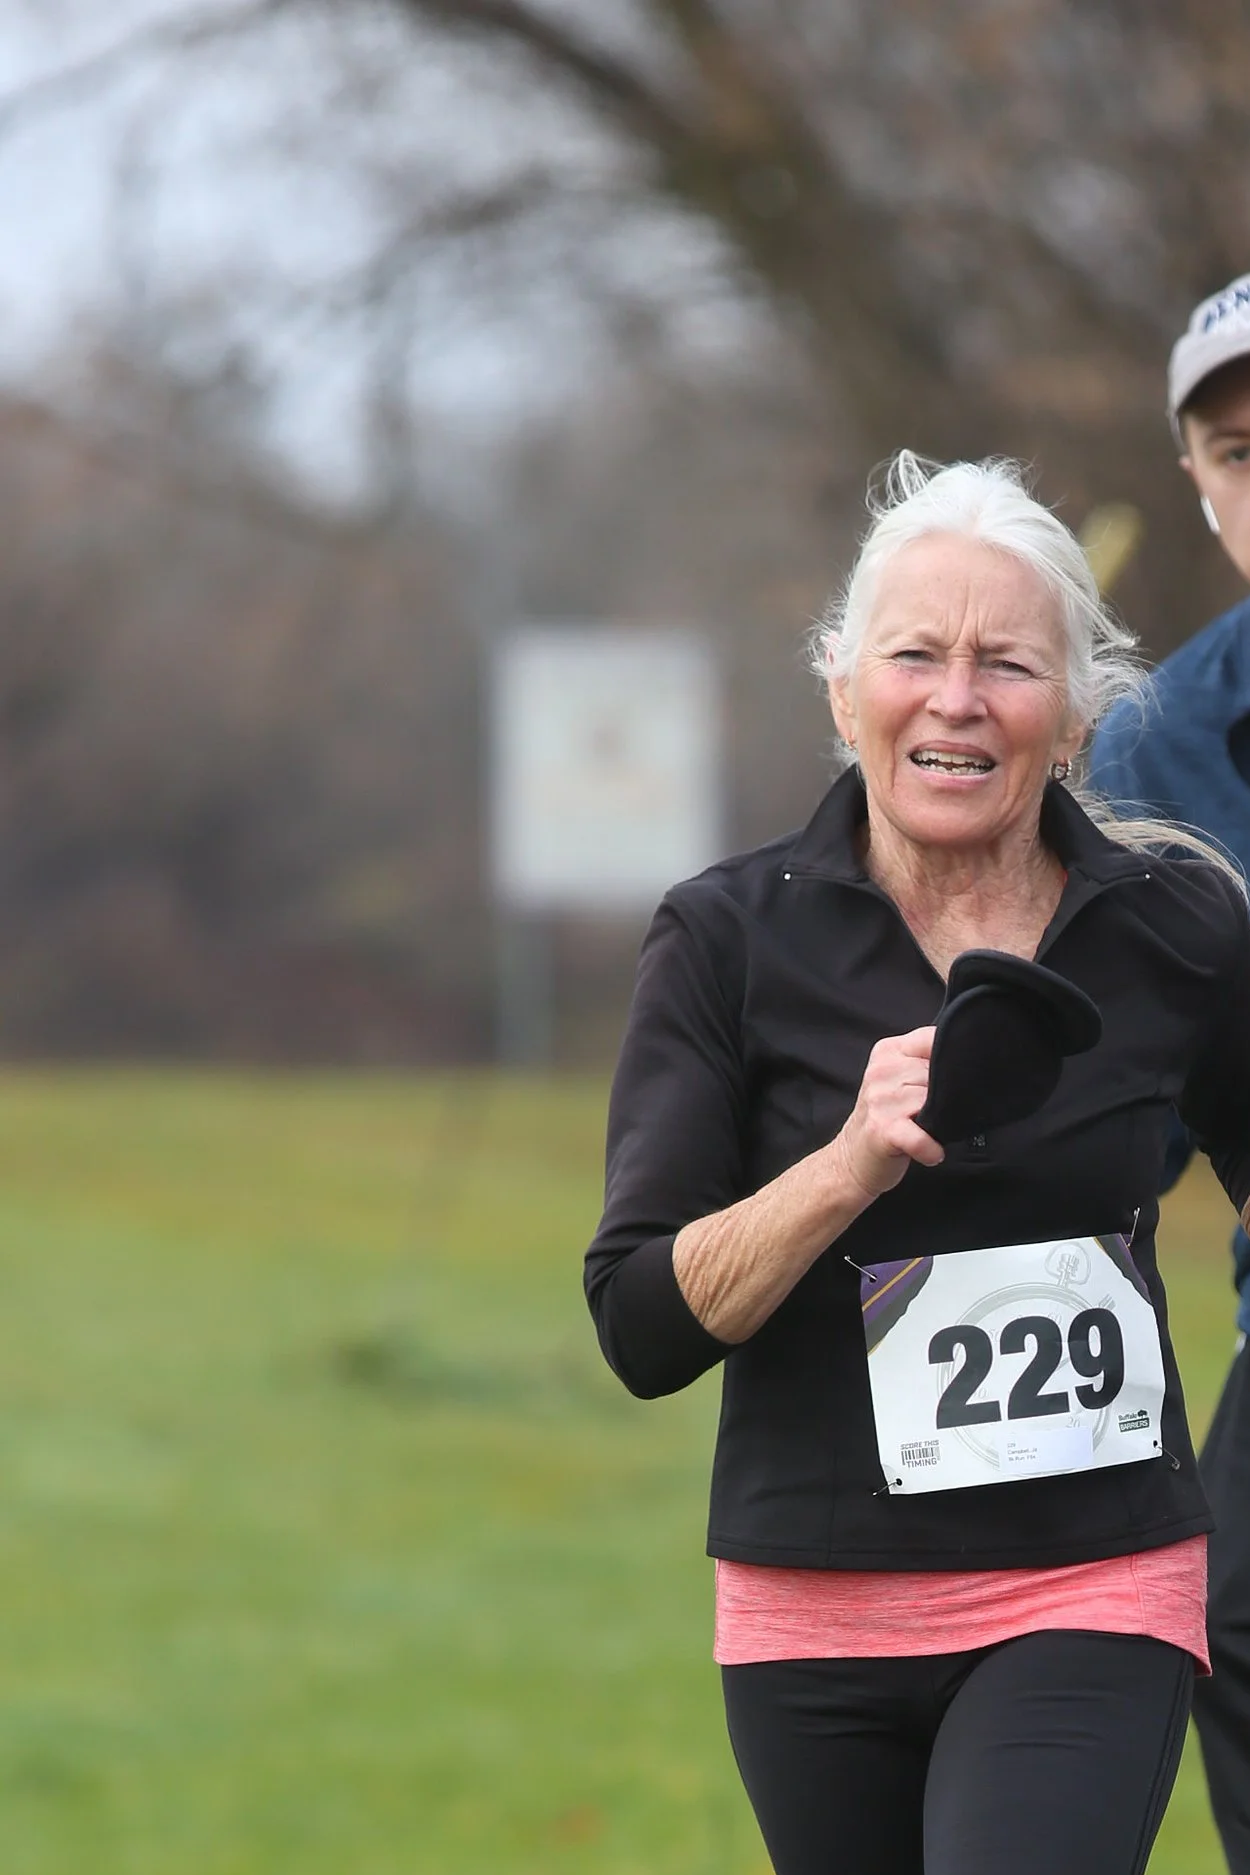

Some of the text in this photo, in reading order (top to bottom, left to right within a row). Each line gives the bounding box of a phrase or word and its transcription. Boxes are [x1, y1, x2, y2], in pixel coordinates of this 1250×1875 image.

[928, 1307, 1125, 1430] 229
[900, 1439, 940, 1450] SCORE THIS
[906, 1457, 938, 1468] TIMING
